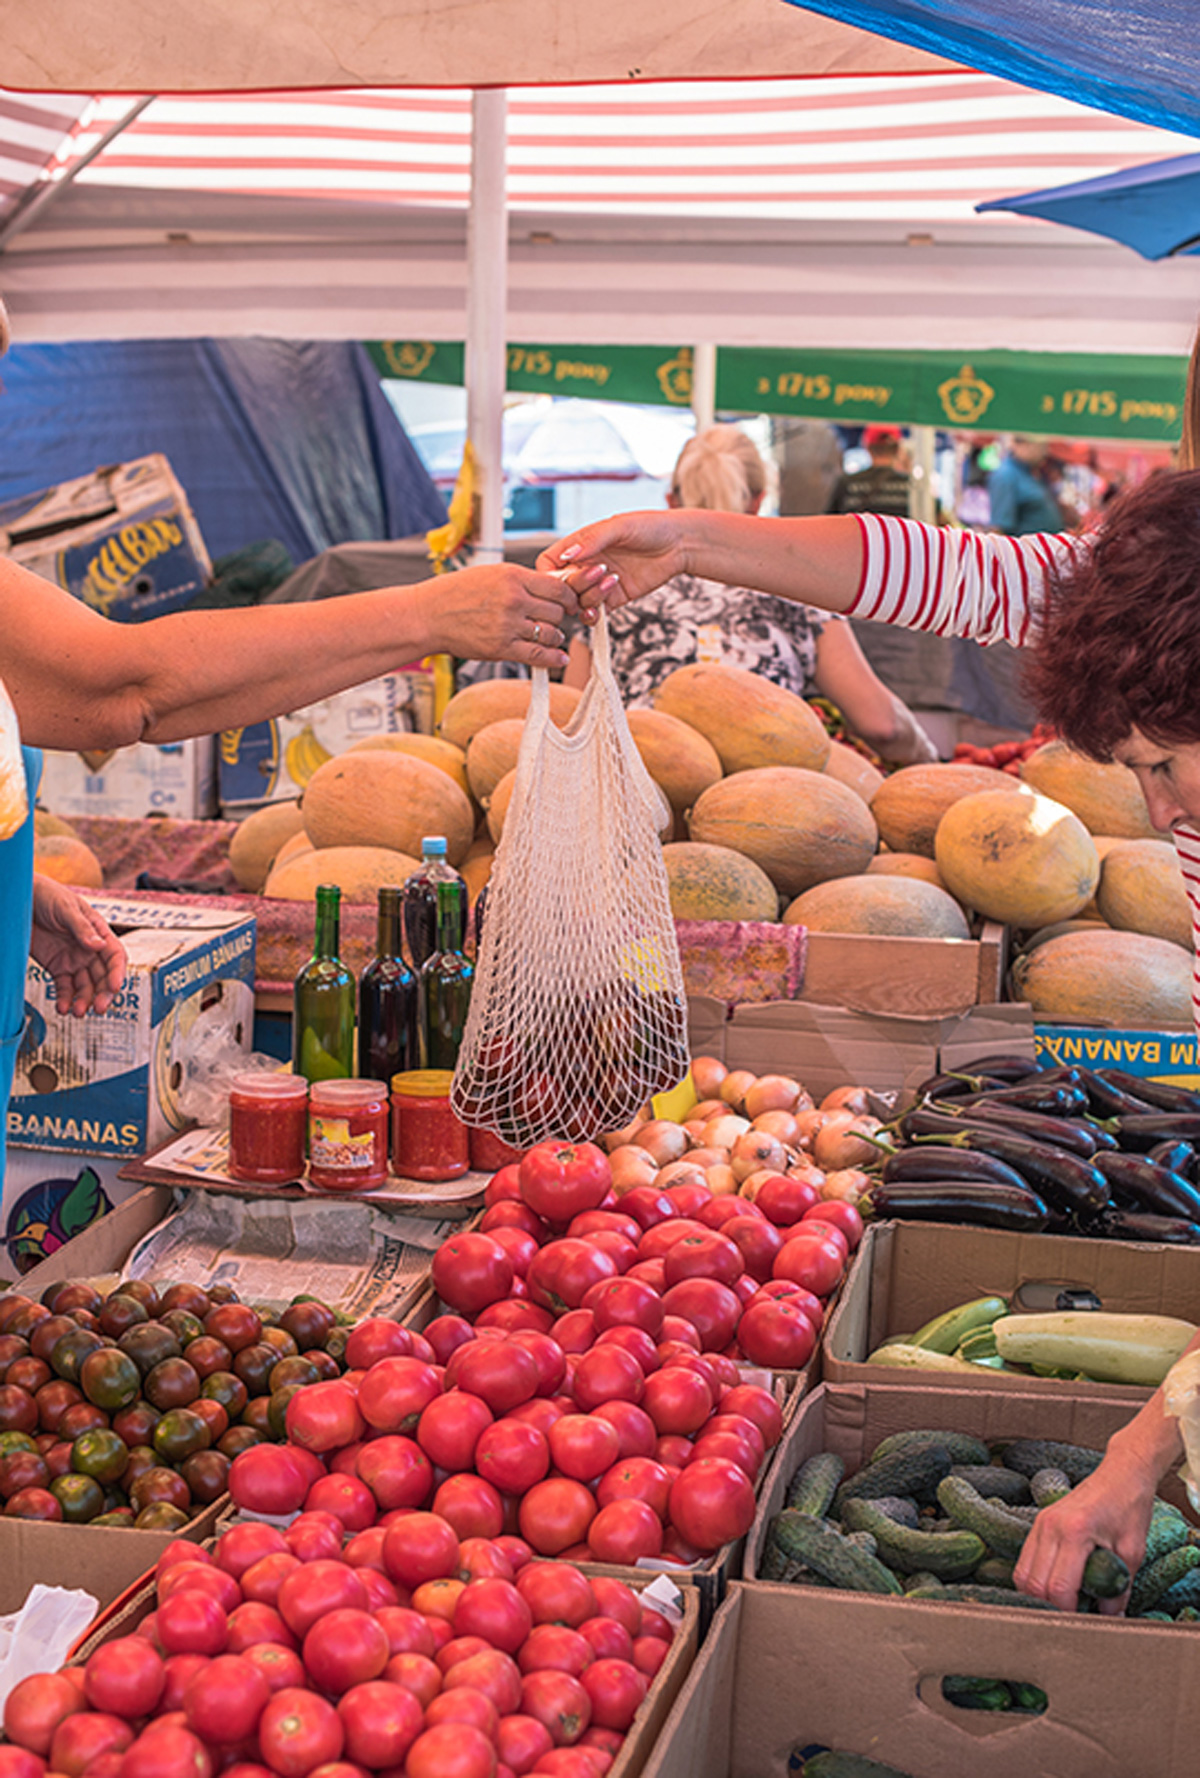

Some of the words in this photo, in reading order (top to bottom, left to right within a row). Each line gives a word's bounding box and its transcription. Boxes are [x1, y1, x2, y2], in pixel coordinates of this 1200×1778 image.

[778, 372, 831, 399] 1715
[1062, 389, 1117, 417] 1715
[164, 953, 212, 997] PREMIUM
[212, 930, 253, 970] BANANAS
[6, 1112, 140, 1146] BANANAS
